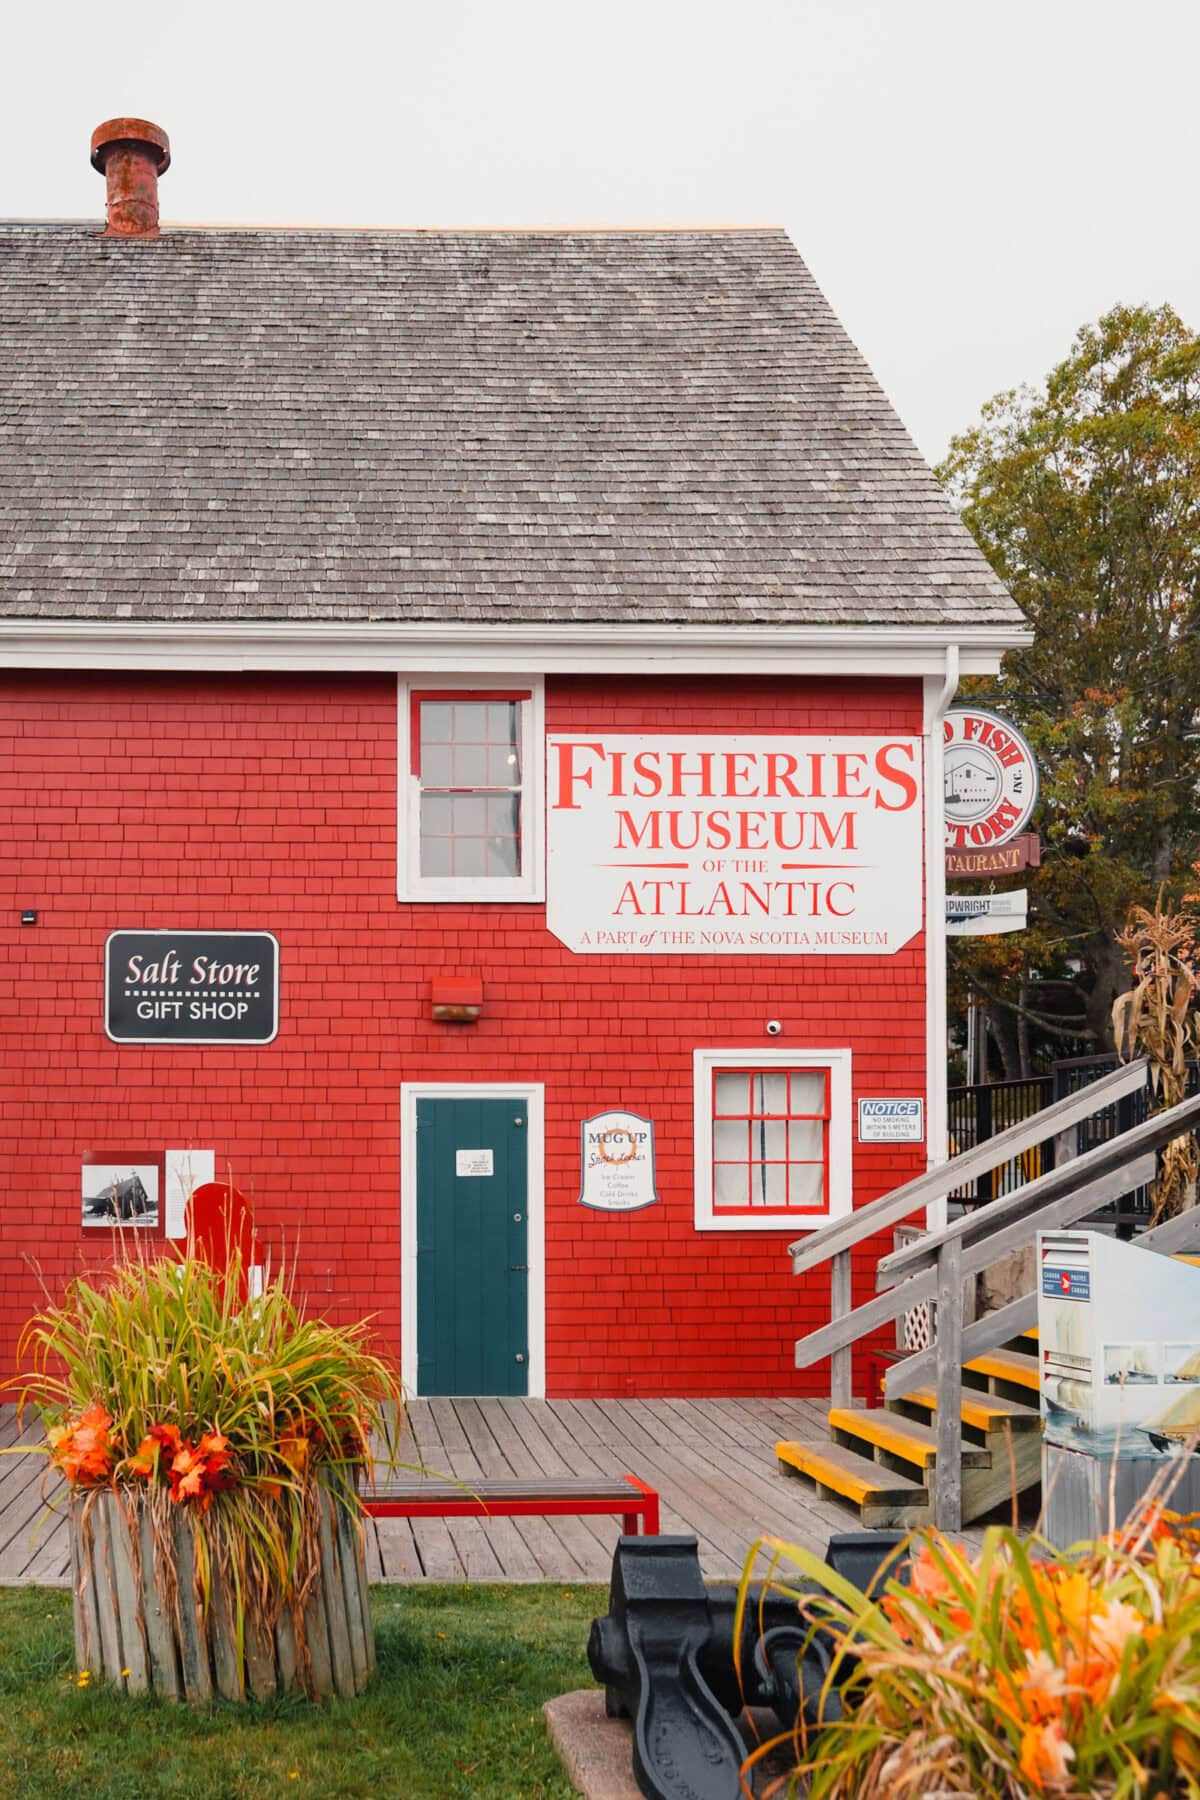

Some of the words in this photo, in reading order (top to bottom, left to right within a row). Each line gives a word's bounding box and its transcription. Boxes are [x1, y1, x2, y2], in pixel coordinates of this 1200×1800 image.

[962, 717, 1025, 769] FISH
[549, 741, 919, 812] FISHERIES
[1012, 769, 1023, 794] INC.
[613, 809, 859, 851] MUSEUM
[702, 859, 726, 873] OF
[731, 859, 768, 873] THE
[611, 879, 856, 917] ATLANTIC
[580, 931, 591, 945] A
[596, 931, 637, 945] PART
[639, 929, 658, 947] of
[662, 931, 695, 945] THE
[699, 931, 745, 945] NOVA
[749, 931, 811, 945] SCOTIA
[815, 931, 889, 945] MUSEUM
[123, 949, 183, 985] Salt
[188, 955, 261, 986] Store
[136, 1001, 184, 1020] GIFT
[189, 1001, 249, 1021] SHOP
[864, 1103, 917, 1115] NOTICE
[588, 1132, 624, 1144] MUG
[627, 1132, 648, 1144] UP
